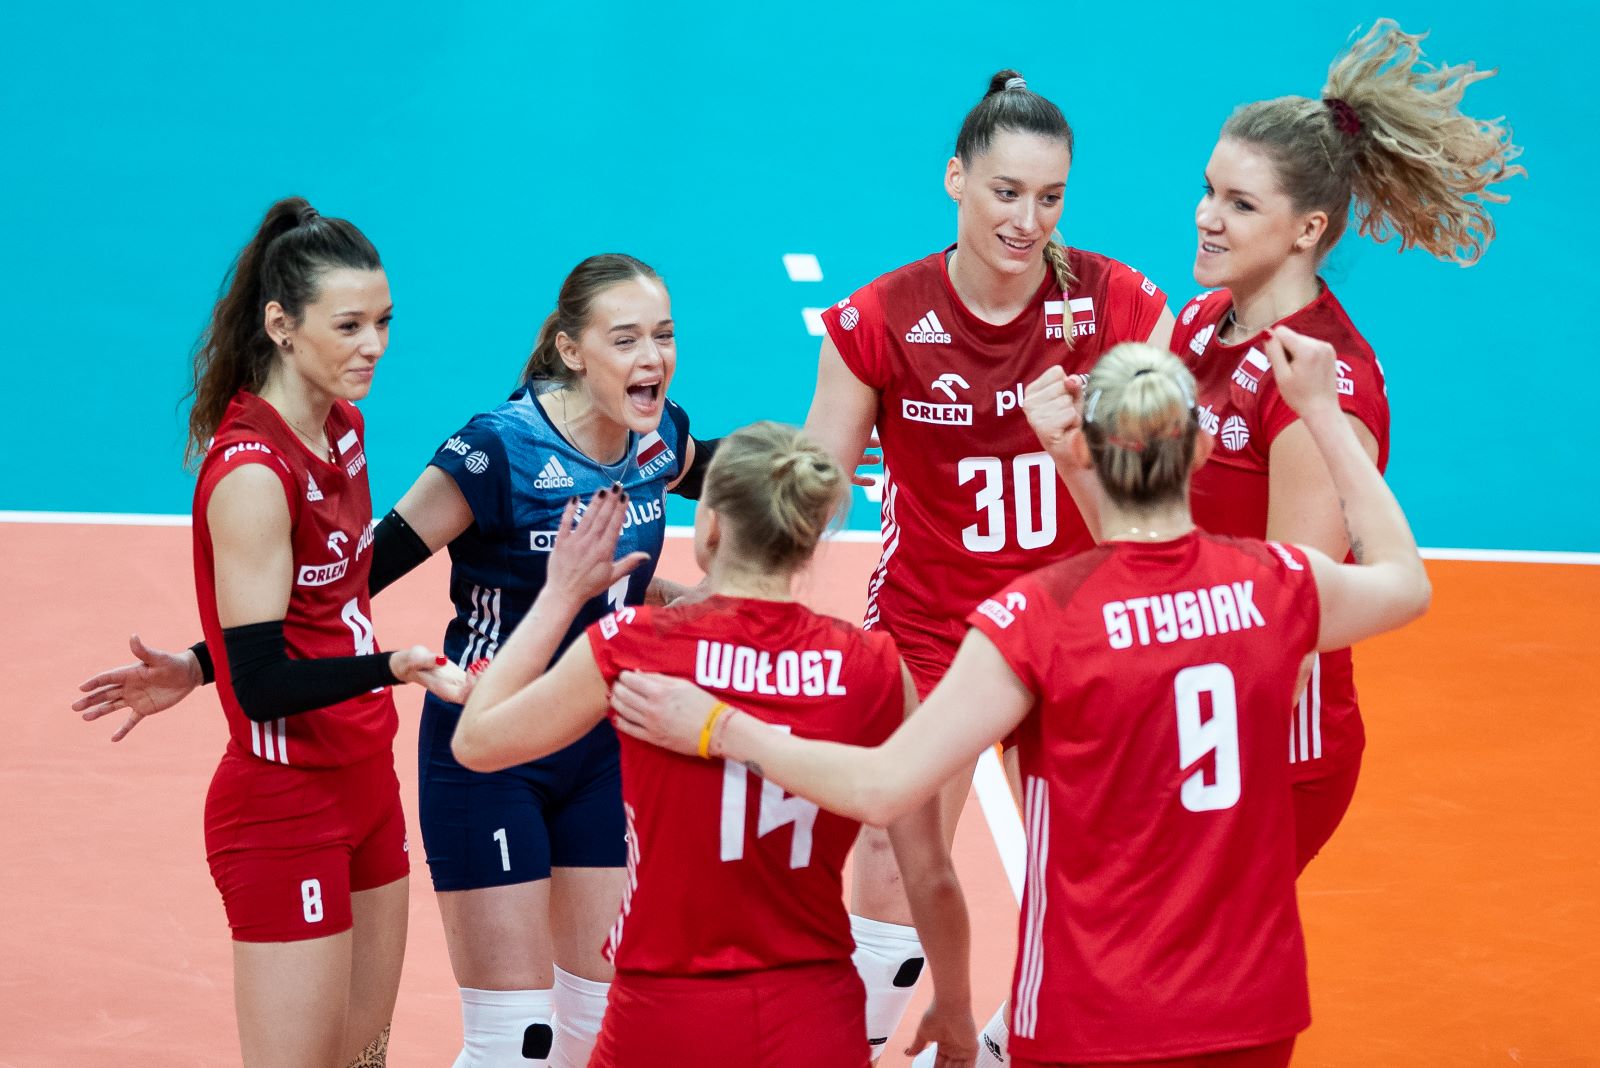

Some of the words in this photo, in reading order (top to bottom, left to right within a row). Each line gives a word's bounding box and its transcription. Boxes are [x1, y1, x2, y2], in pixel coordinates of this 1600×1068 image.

[905, 331, 952, 344] adidas
[1046, 324, 1096, 339] POSKA
[905, 404, 968, 422] ORLEN
[996, 382, 1024, 417] pl
[224, 442, 272, 462] plus
[440, 435, 472, 456] plus
[639, 450, 676, 479] POLSKA
[533, 475, 575, 490] adidas
[957, 451, 1058, 553] 30
[303, 561, 346, 583] ORLEN
[1102, 580, 1266, 650] STYSIAK
[695, 639, 847, 697] WOŁOSZ
[1174, 662, 1242, 813] 9
[720, 724, 820, 870] 14
[493, 828, 511, 871] 1
[301, 878, 324, 923] 8
